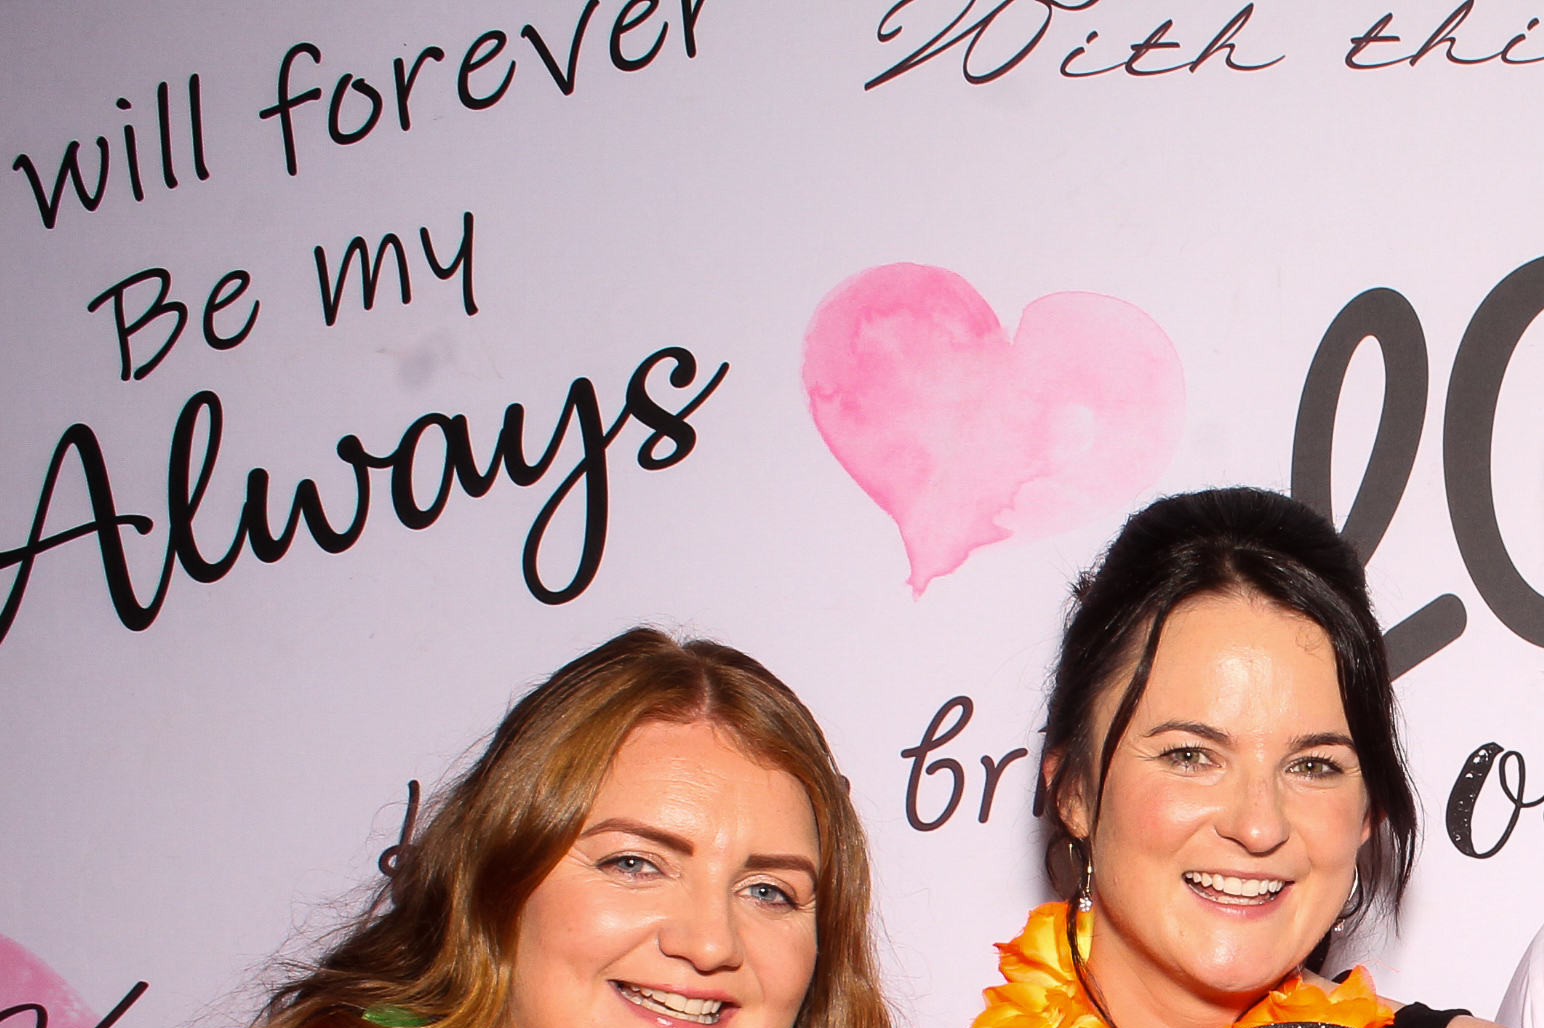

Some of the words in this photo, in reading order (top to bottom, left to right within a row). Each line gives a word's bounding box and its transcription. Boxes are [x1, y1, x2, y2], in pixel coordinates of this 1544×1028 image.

[12, 72, 210, 229] will
[258, 0, 708, 177] forever
[865, 0, 1285, 91] With
[87, 267, 261, 381] Be
[313, 211, 480, 326] my
[0, 346, 731, 645] Always
